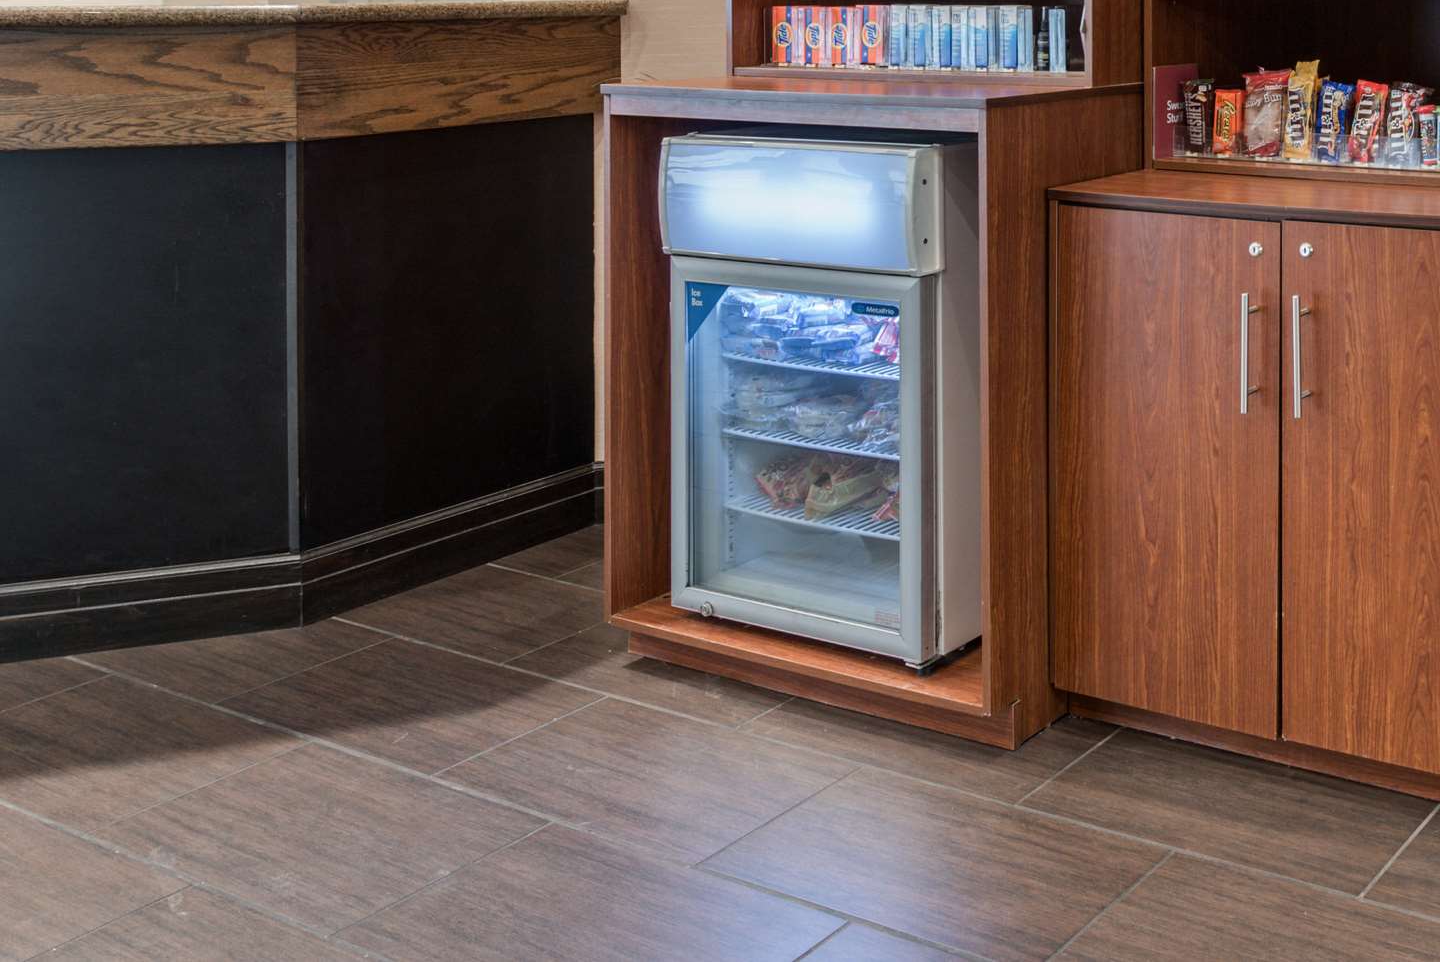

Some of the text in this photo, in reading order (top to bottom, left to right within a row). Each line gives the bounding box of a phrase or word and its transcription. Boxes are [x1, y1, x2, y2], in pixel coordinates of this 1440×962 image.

[1185, 91, 1203, 146] HERSHEY'S
[691, 288, 701, 298] Ice
[691, 298, 703, 308] Box
